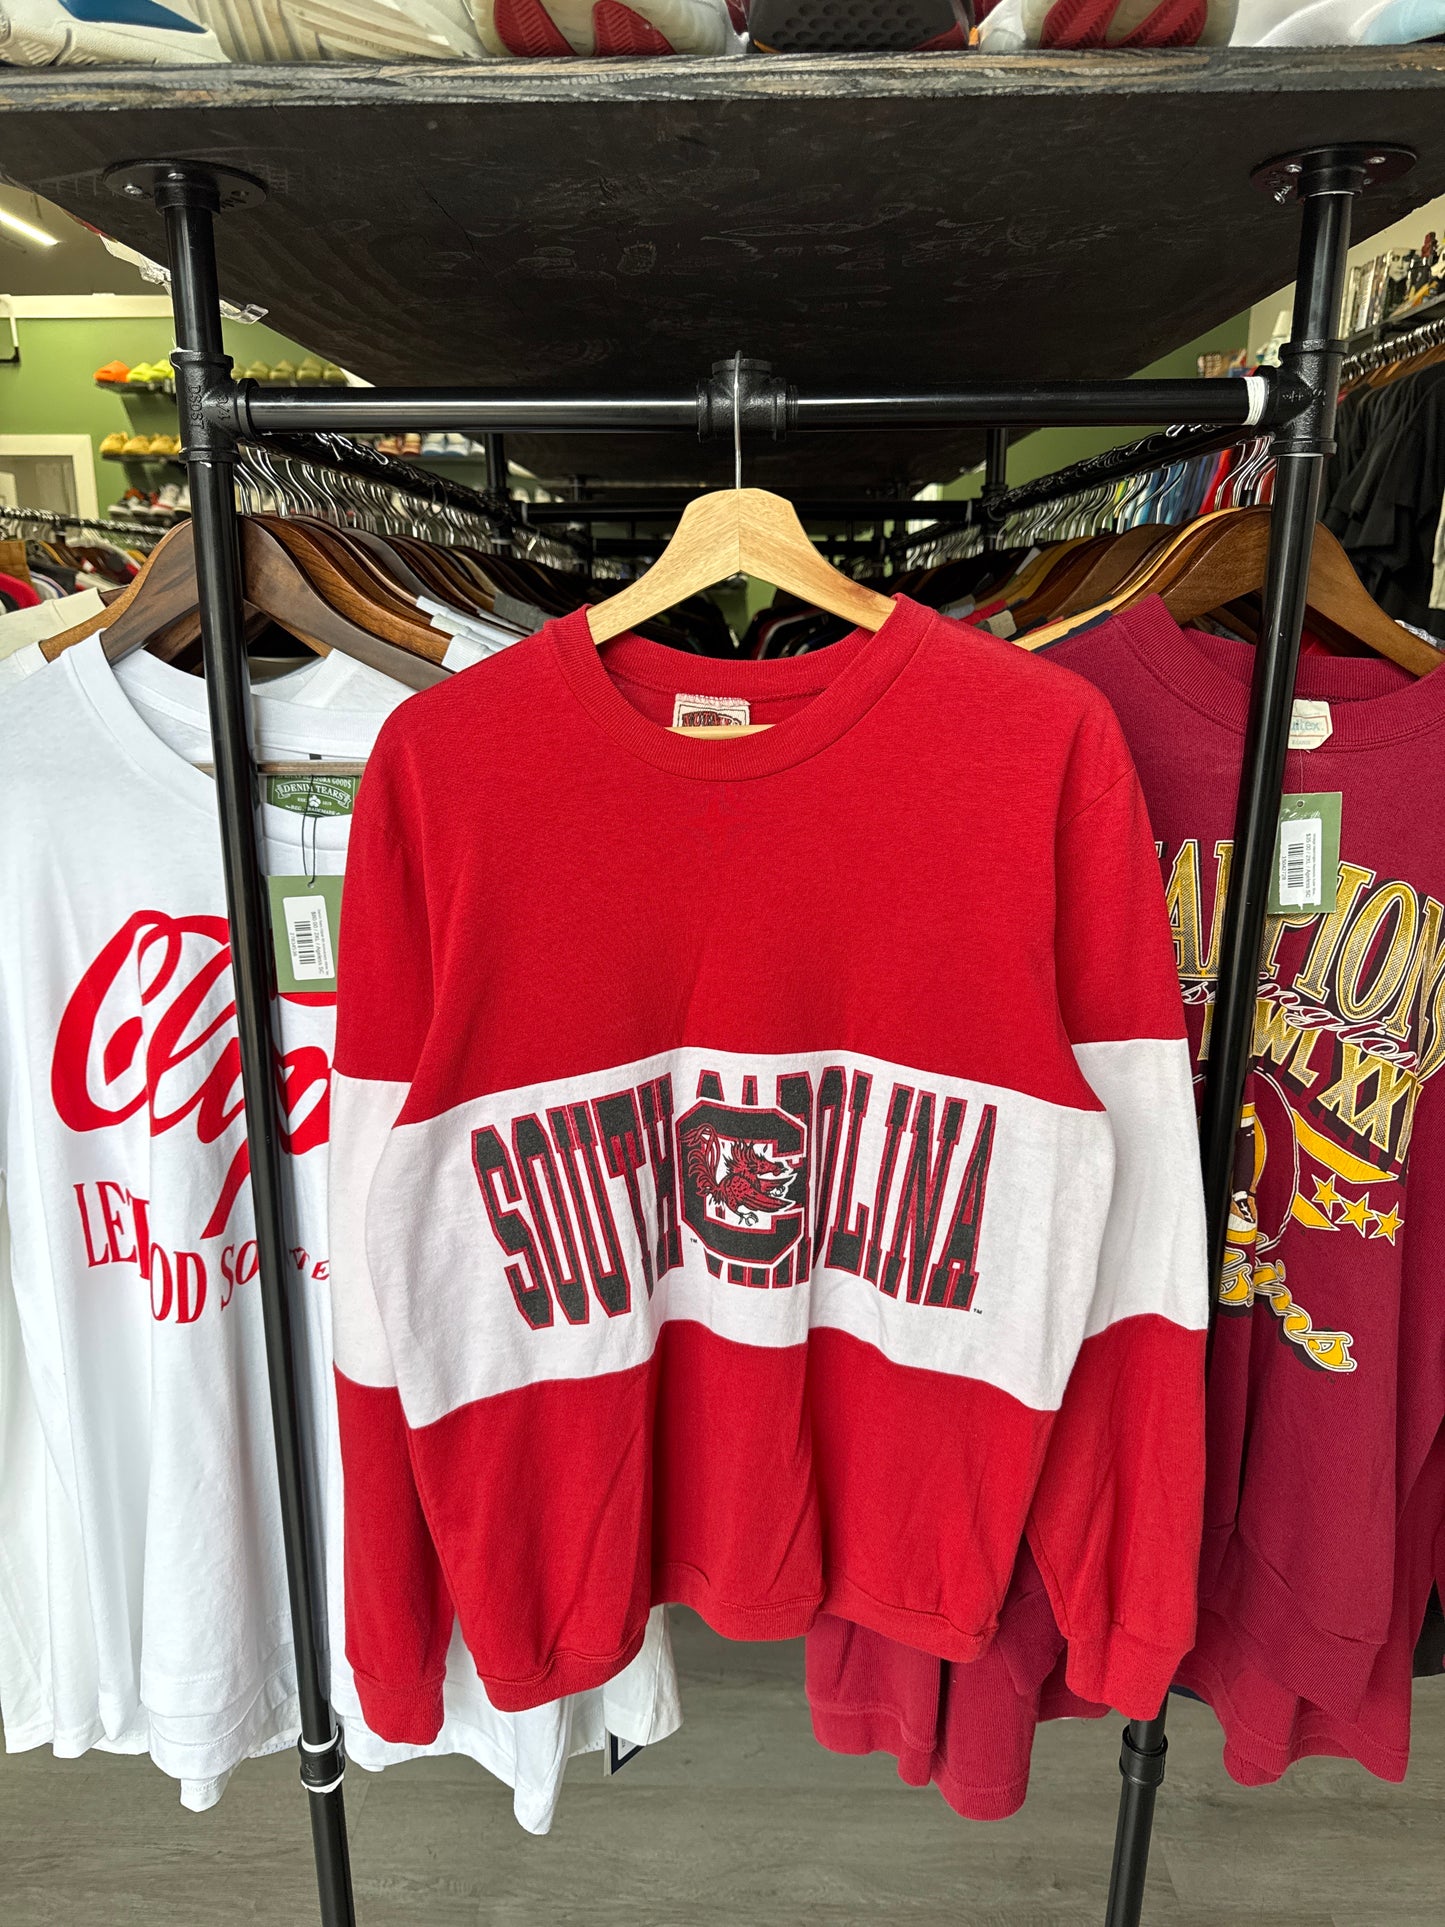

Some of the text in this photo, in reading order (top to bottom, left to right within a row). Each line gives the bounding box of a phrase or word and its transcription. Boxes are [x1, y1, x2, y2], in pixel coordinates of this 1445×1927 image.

[283, 783, 344, 800] DENIM TEARS
[471, 1072, 684, 1331] SOUTH
[150, 1241, 207, 1324] OD
